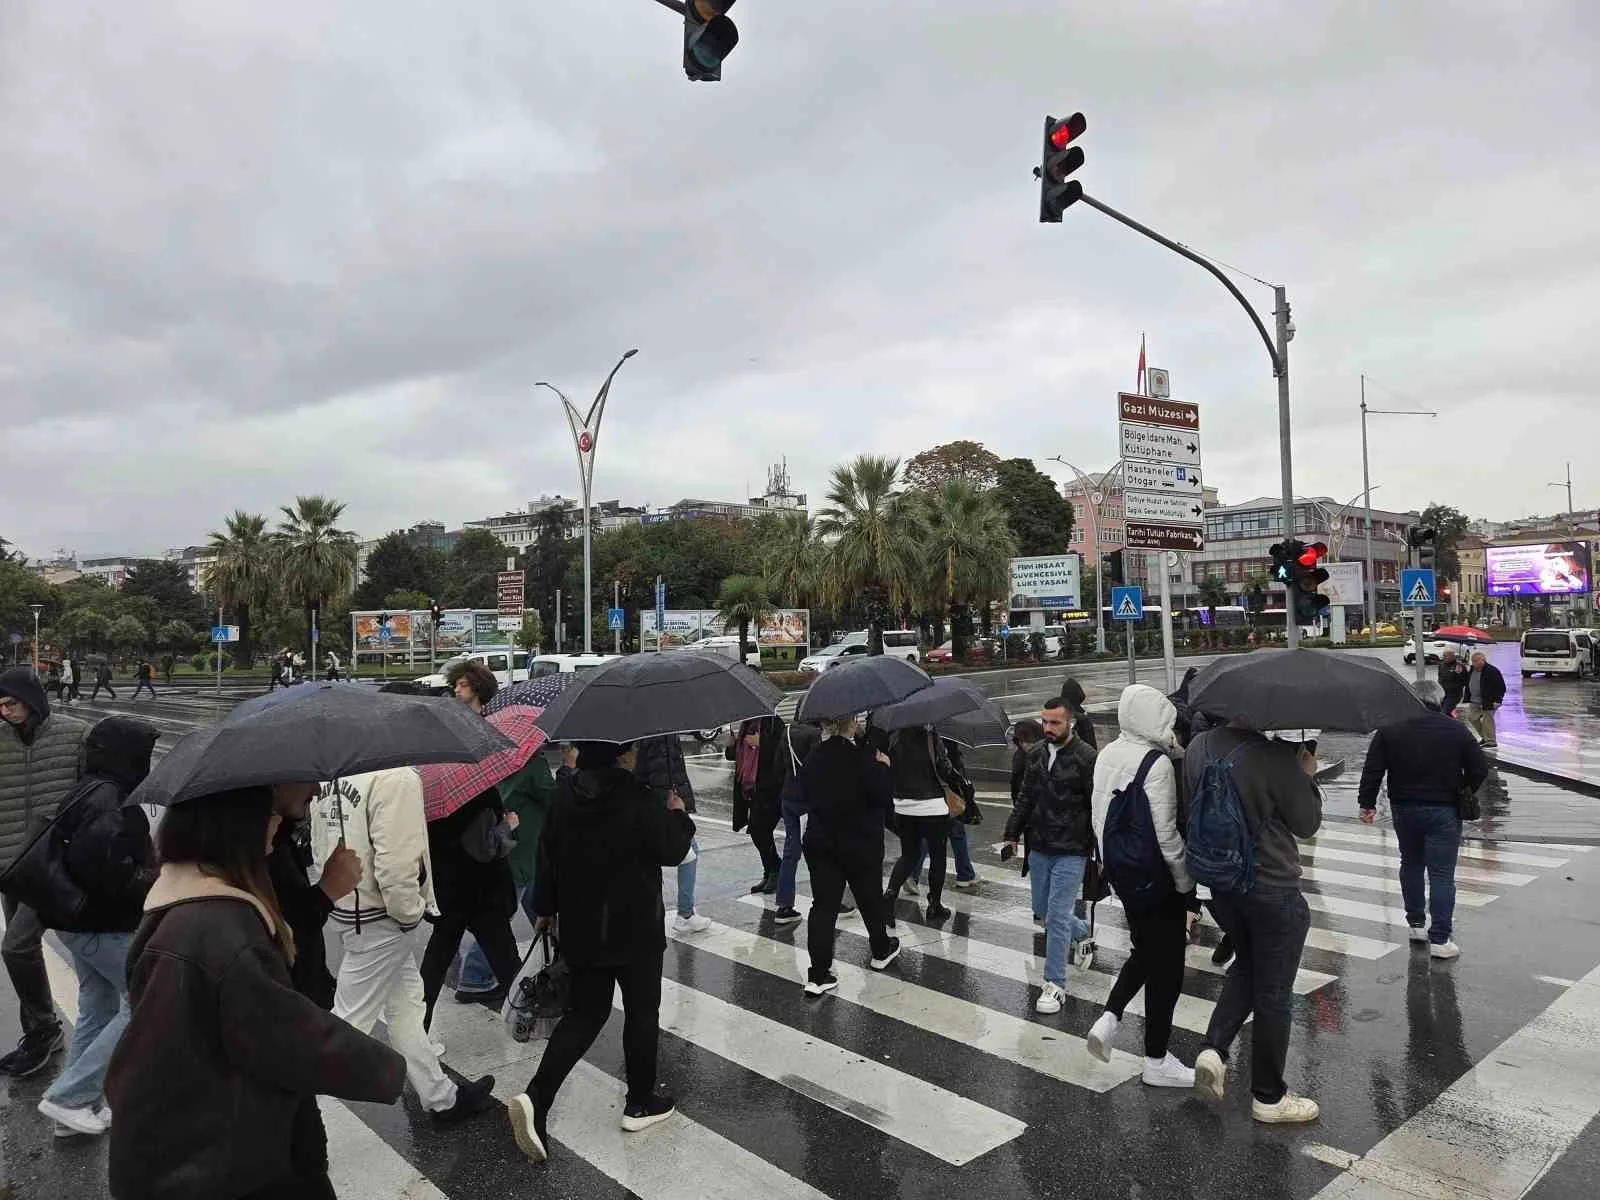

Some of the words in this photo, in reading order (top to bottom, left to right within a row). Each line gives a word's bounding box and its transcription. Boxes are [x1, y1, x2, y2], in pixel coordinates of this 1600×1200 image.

[1123, 402, 1146, 415] Gazi
[1148, 404, 1185, 421] Müzesi
[1124, 429, 1146, 443] Bölge
[1125, 443, 1172, 458] Kütüphane
[1127, 463, 1174, 477] Hastaneler
[1127, 475, 1157, 487] Otogar
[1127, 527, 1146, 537] Tarihi
